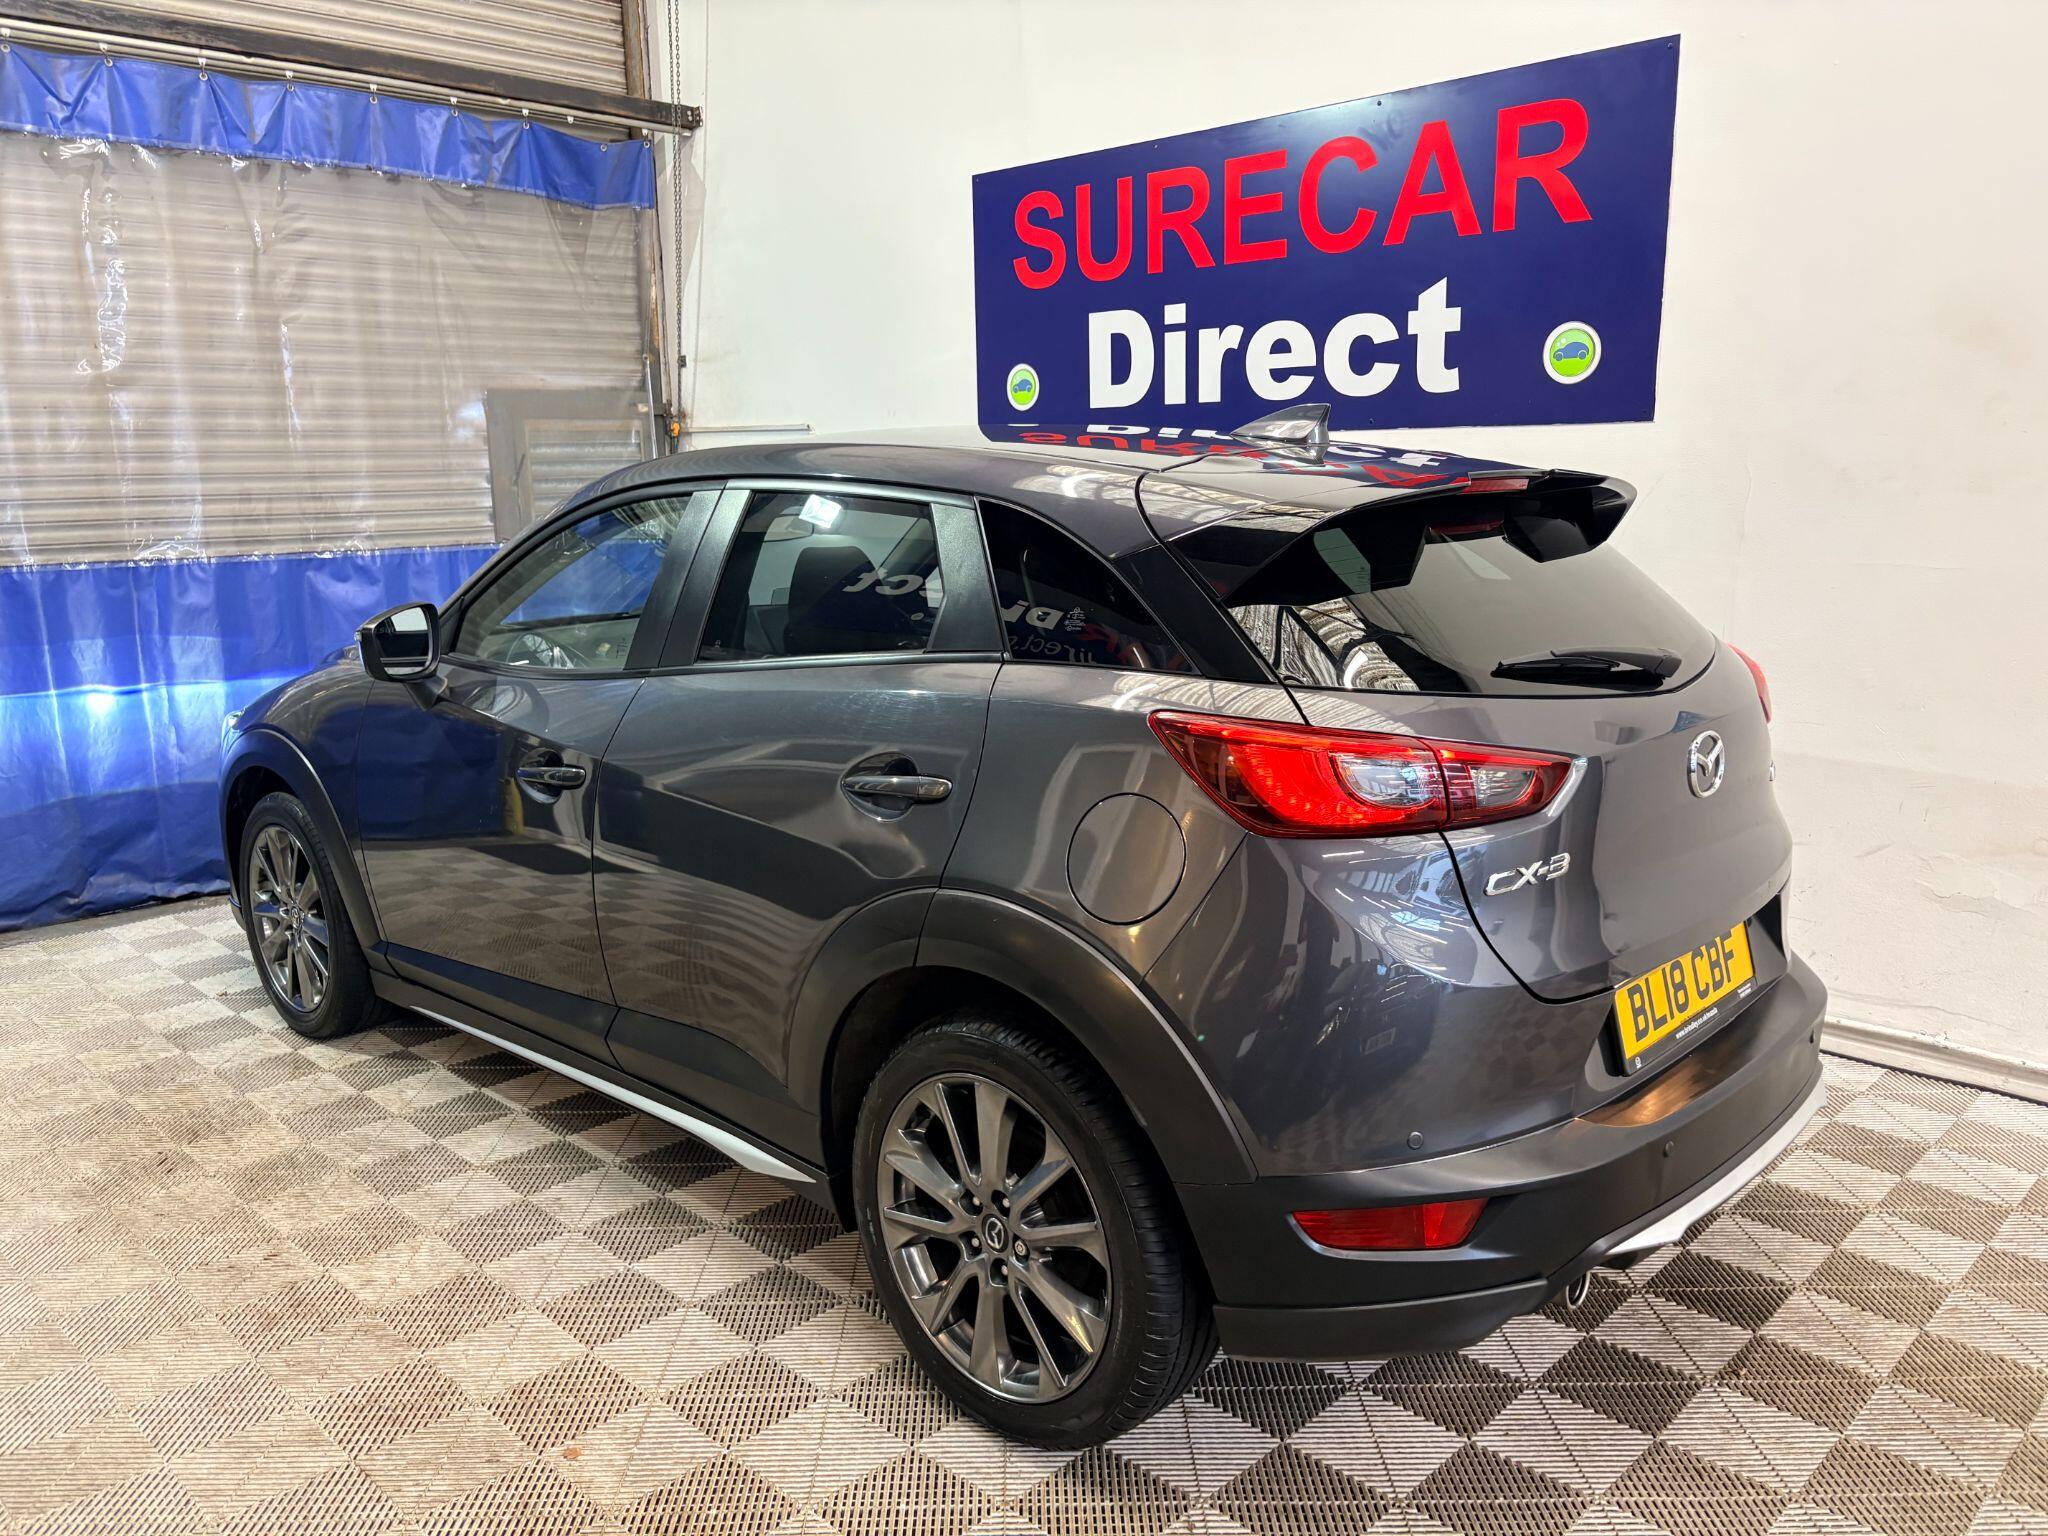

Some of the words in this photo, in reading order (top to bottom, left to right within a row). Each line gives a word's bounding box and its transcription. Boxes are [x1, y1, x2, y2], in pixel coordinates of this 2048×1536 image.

[1013, 98, 1593, 290] SURECAR
[1087, 276, 1462, 409] Direct
[1483, 852, 1571, 896] CX-3
[1627, 959, 1690, 1043] BL18
[1691, 929, 1735, 1000] CBF
